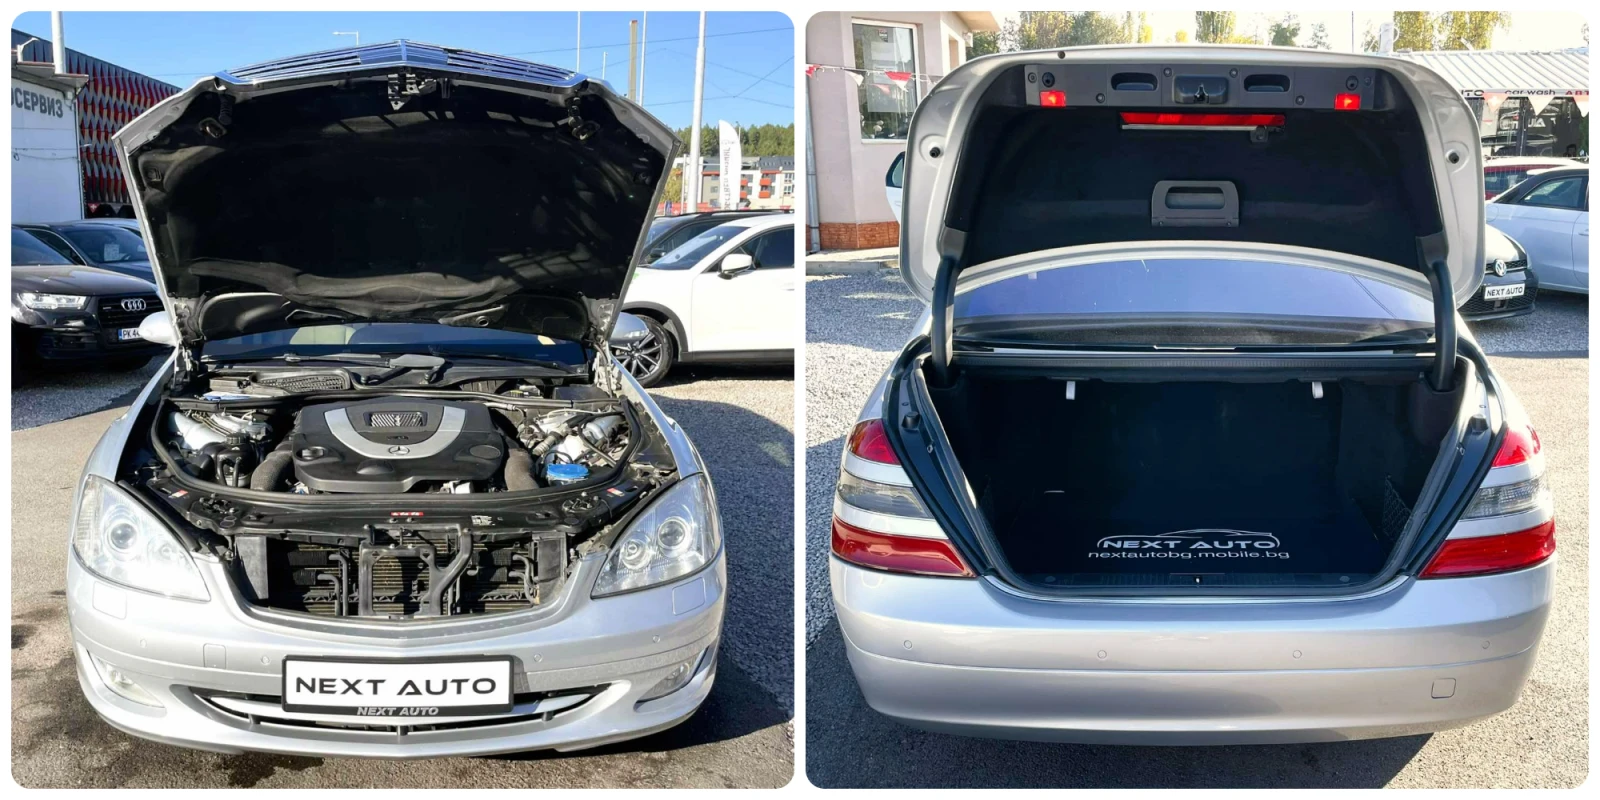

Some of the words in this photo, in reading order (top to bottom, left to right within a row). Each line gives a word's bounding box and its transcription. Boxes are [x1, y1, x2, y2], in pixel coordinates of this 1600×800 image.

[1486, 288, 1505, 297] NEXT
[1505, 286, 1523, 295] AUTO
[1103, 541, 1182, 549] NEXT
[1189, 541, 1276, 549] AUTO
[1088, 551, 1290, 559] nextautobg.mobile.bg
[296, 677, 387, 695] NEXT
[396, 677, 497, 696] AUTO
[356, 707, 397, 716] NEXT
[399, 707, 439, 716] AUTO
